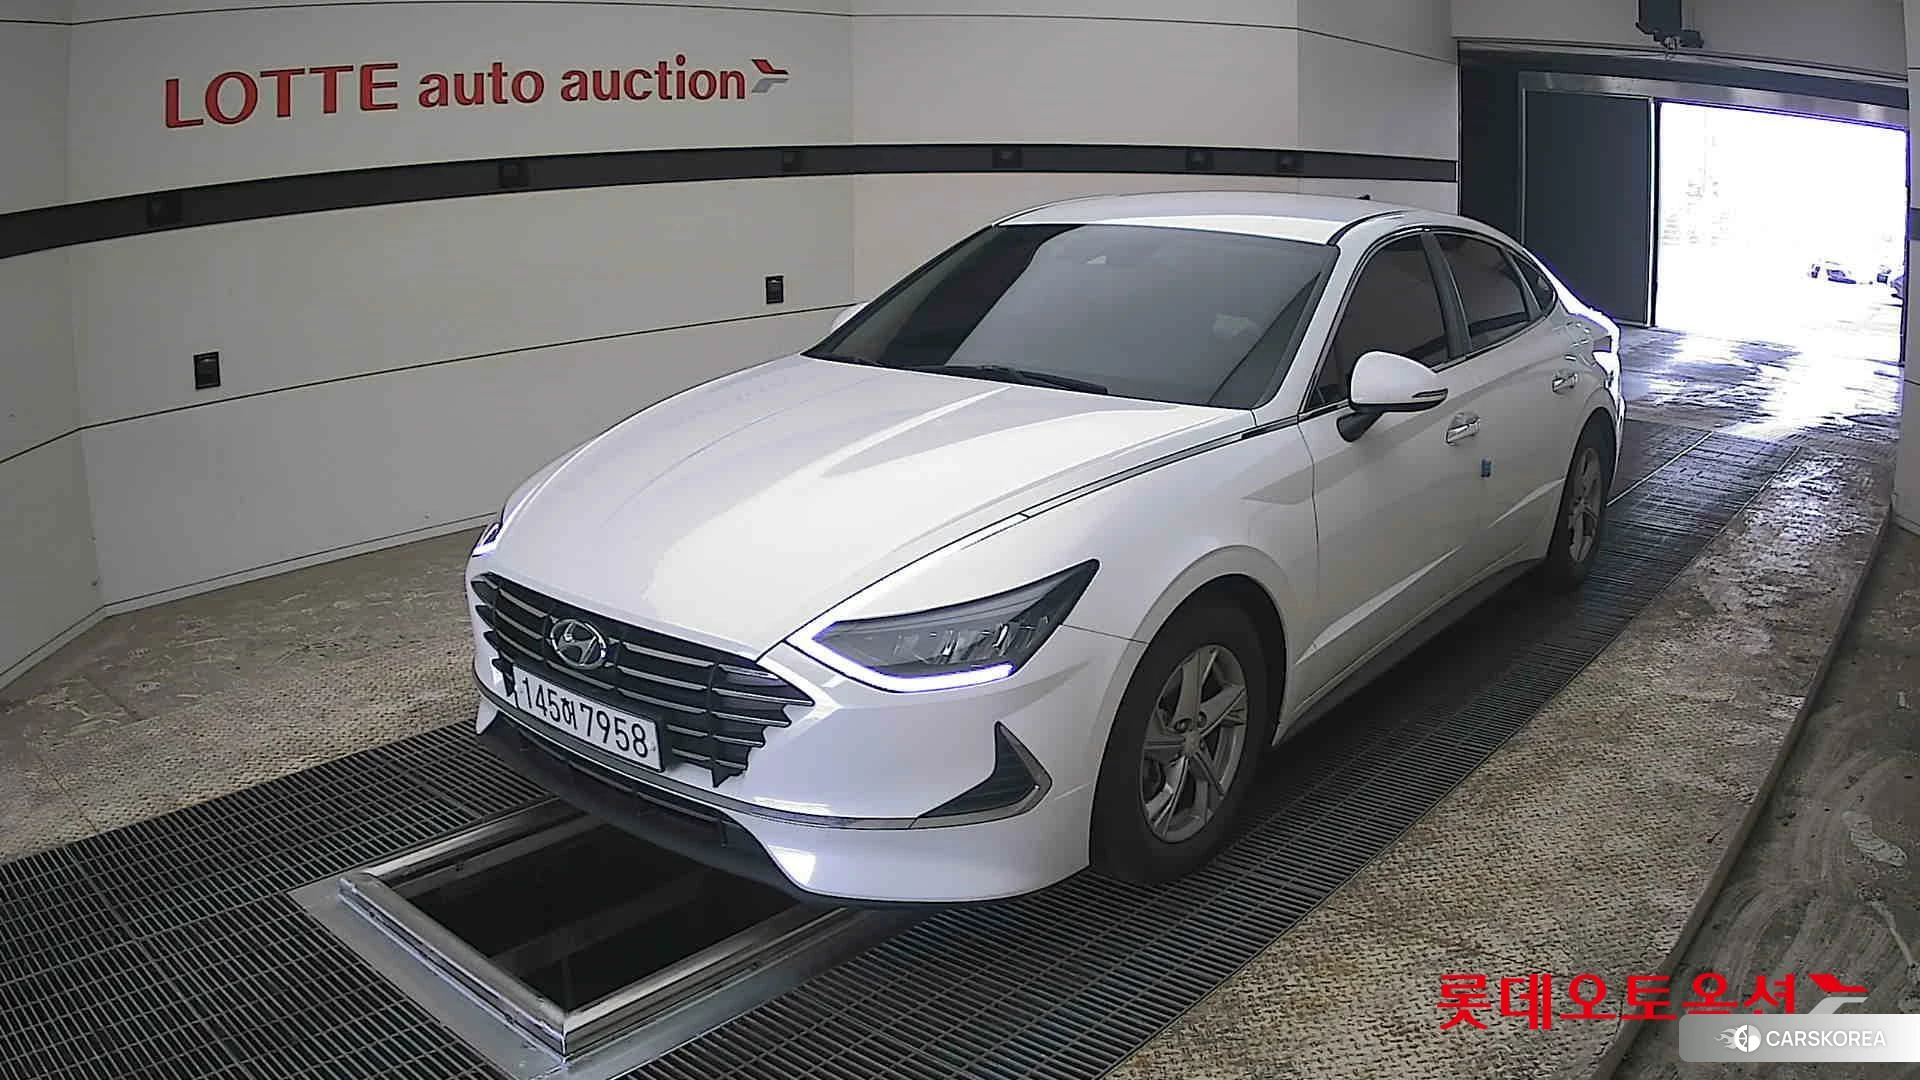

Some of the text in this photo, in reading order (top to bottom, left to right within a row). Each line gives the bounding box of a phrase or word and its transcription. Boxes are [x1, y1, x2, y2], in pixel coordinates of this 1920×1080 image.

[165, 54, 747, 128] LOTTE auto auction
